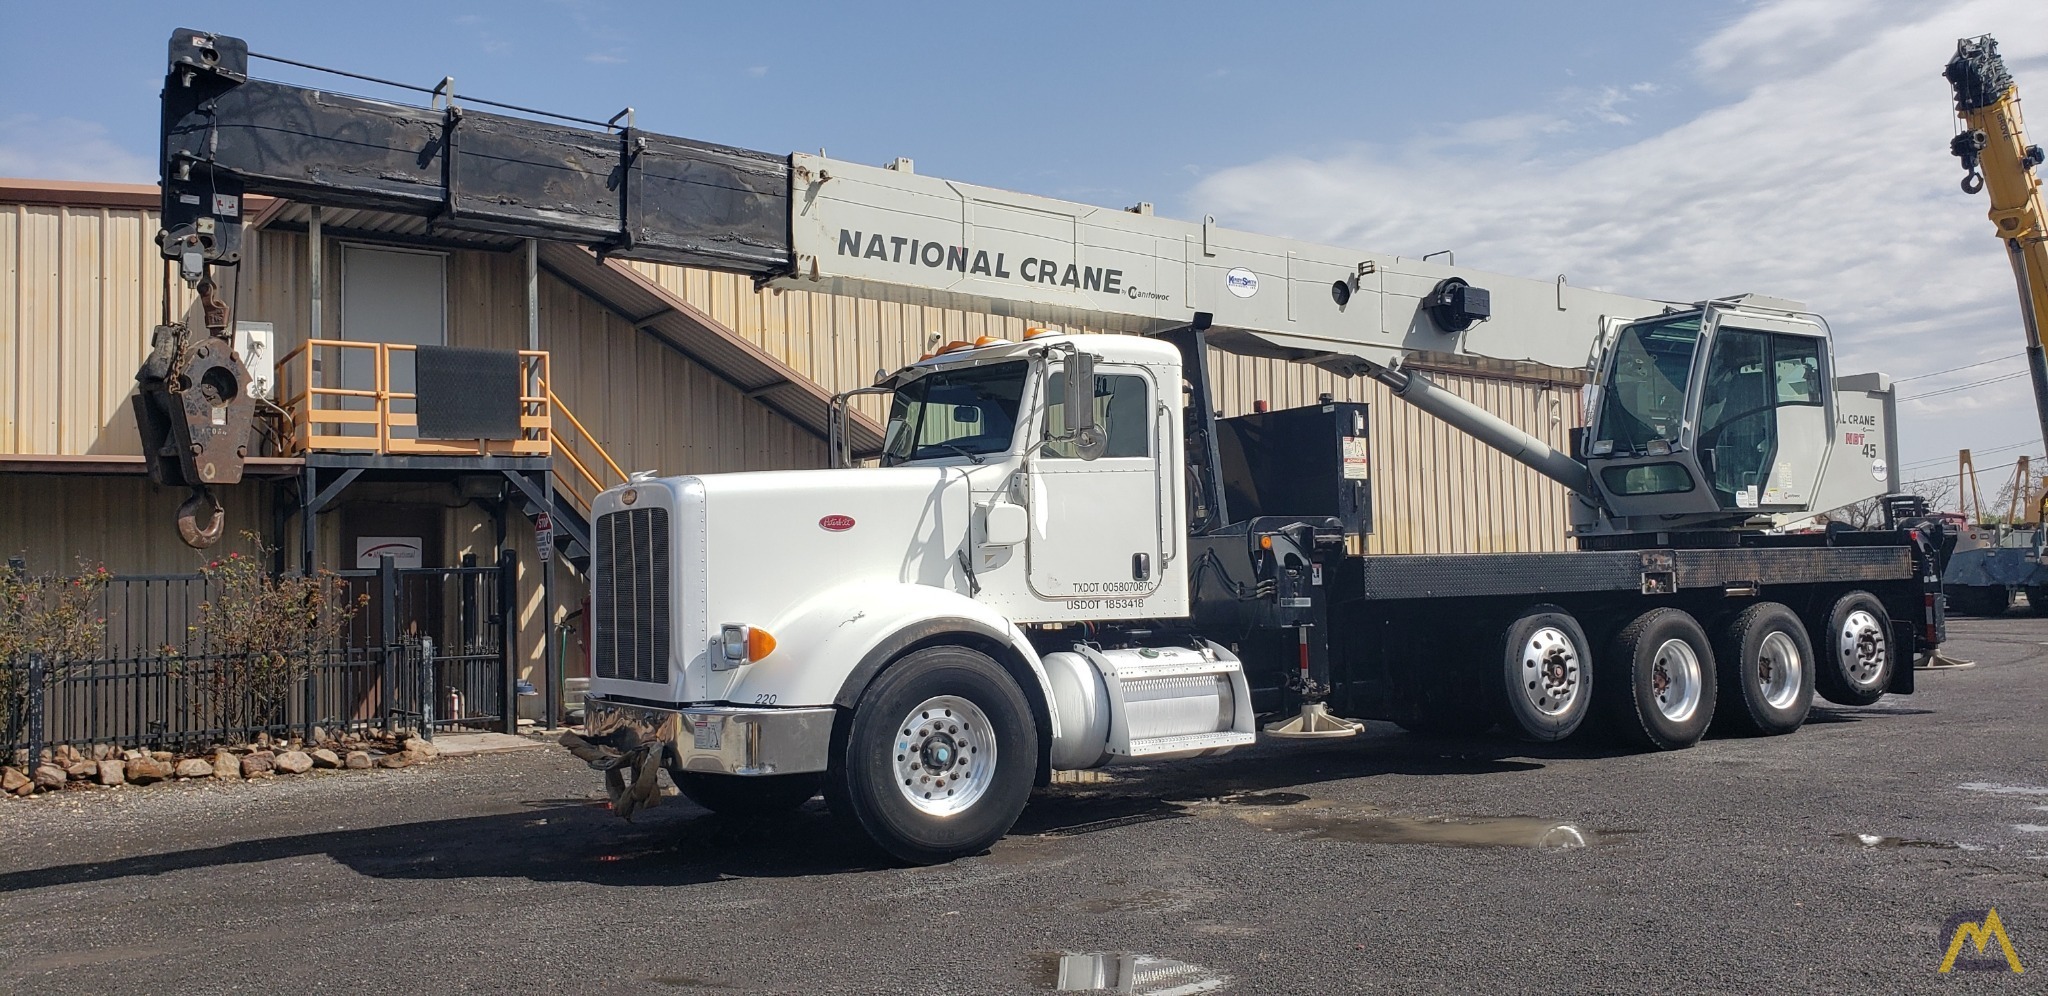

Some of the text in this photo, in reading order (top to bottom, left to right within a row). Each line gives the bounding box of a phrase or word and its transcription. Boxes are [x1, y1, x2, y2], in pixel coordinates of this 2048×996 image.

[1997, 113, 2010, 141] GROVE
[838, 229, 1123, 294] NATIONAL CRANE
[1848, 414, 1875, 426] CRANE
[1845, 432, 1865, 445] NBT
[1862, 443, 1876, 458] 45
[538, 517, 549, 529] STOP
[1073, 581, 1154, 592] TXDOT 005807087C
[1066, 599, 1144, 610] USDOT 1853418
[755, 693, 777, 705] 220
